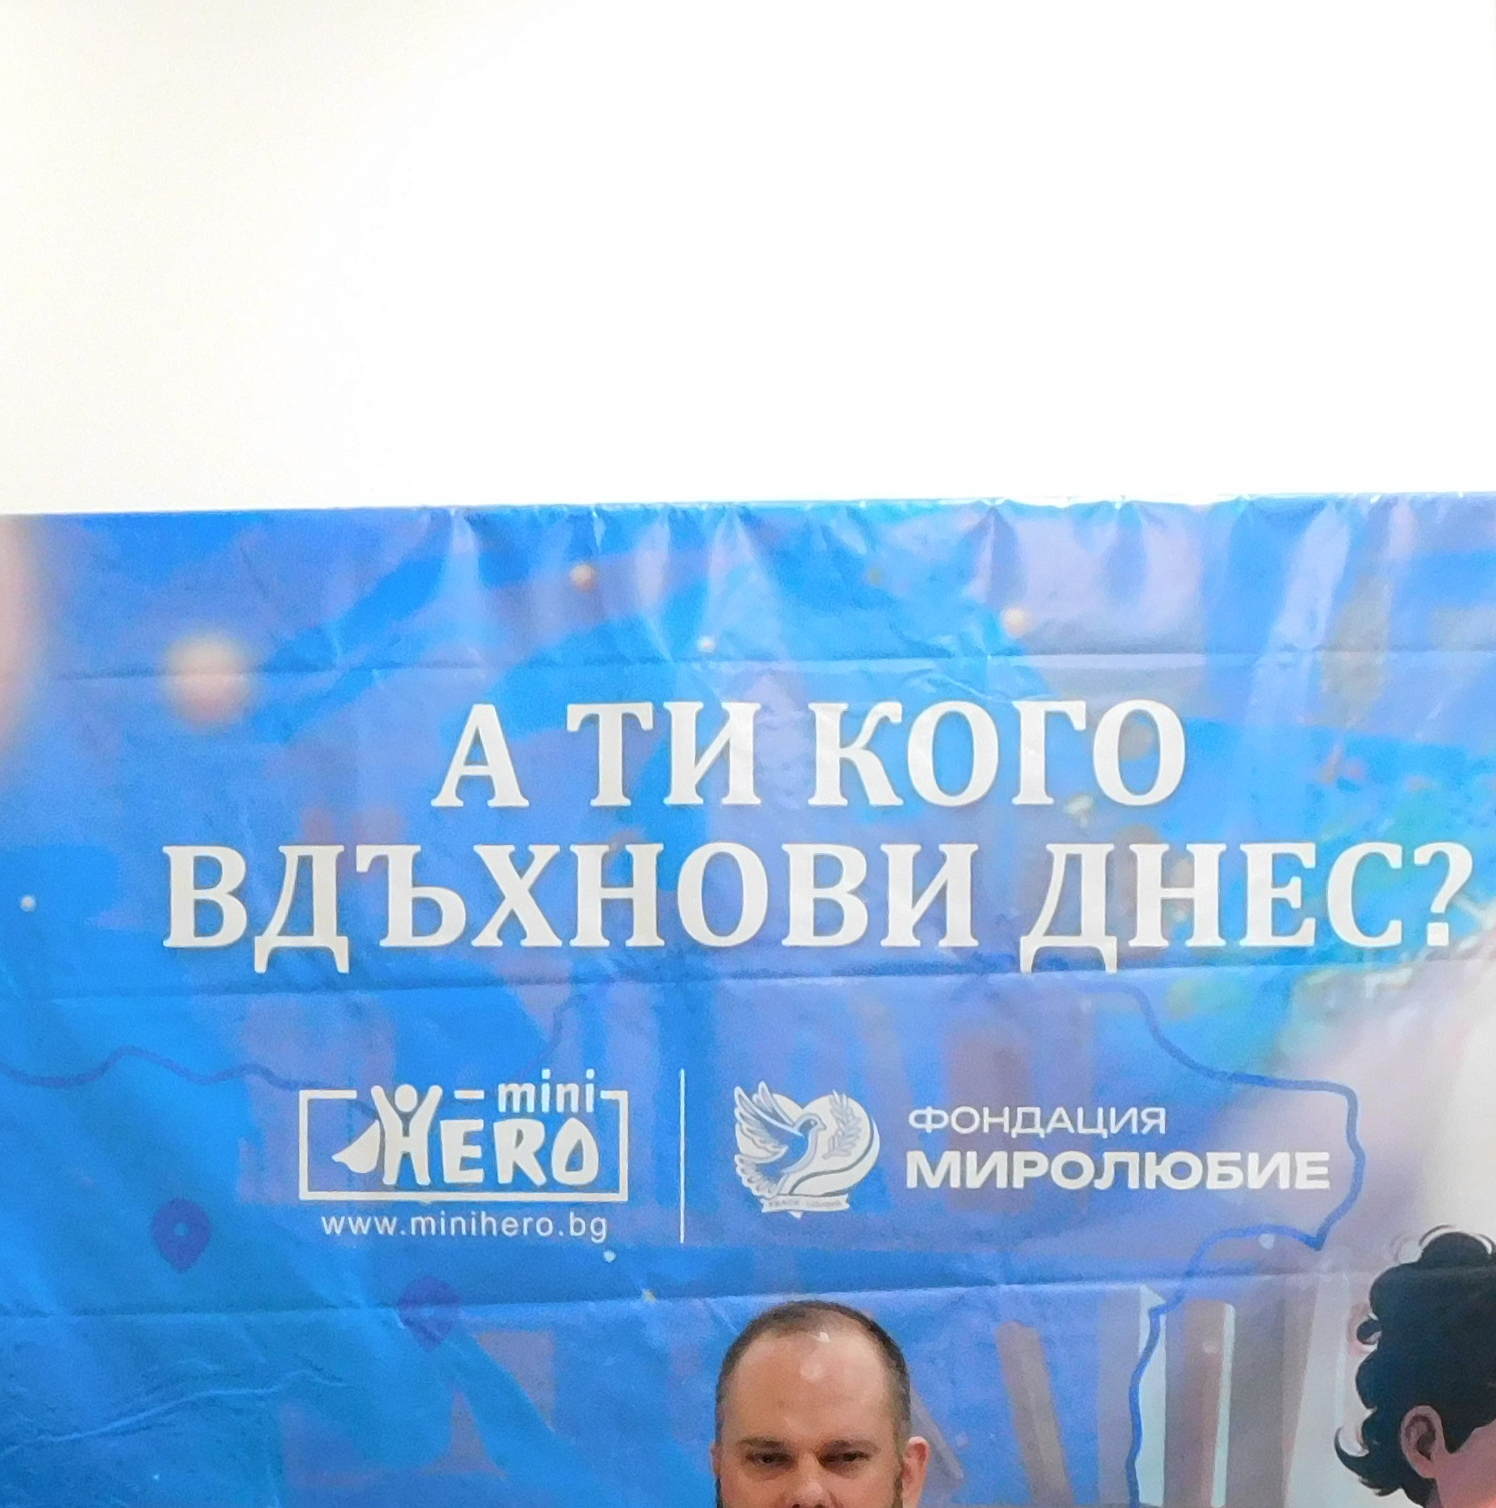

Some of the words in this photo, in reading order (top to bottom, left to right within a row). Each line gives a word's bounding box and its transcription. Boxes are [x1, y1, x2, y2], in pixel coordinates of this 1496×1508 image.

[431, 703, 529, 808] А
[567, 702, 763, 808] ТИ
[811, 699, 1186, 810] КОГО
[162, 844, 986, 973] ВДЪХНОВИ
[1018, 844, 1475, 973] ДНЕС?
[498, 1068, 595, 1113] mini
[371, 1084, 599, 1186] HERO
[908, 1105, 1167, 1137] ФОНДАЦИЯ
[905, 1150, 1331, 1192] МИРОЛЮБИЕ
[321, 1210, 608, 1243] www.minihero.bg
